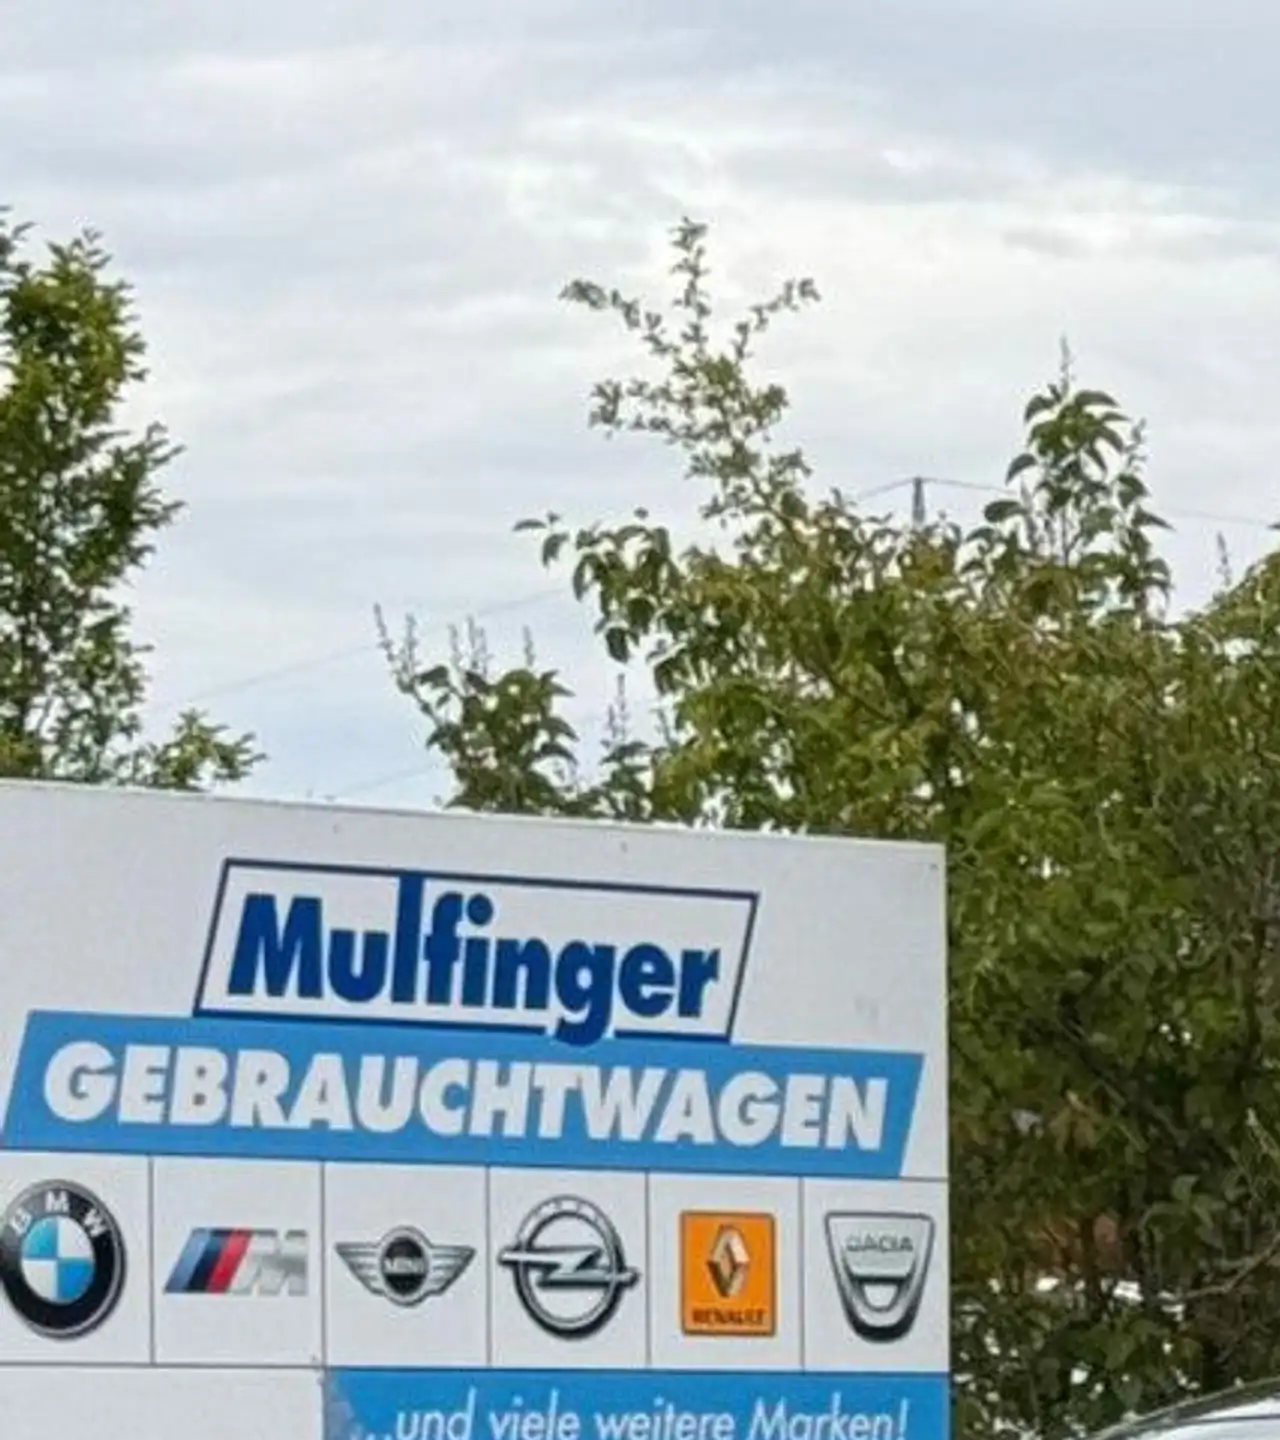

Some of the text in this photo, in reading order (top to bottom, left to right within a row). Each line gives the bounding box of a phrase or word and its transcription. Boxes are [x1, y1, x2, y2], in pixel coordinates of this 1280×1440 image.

[228, 872, 720, 1045] Mulfinger
[43, 1039, 893, 1152] GEBRAUCHTWAGEN
[10, 1189, 106, 1238] BMW
[846, 1234, 914, 1252] DACIA
